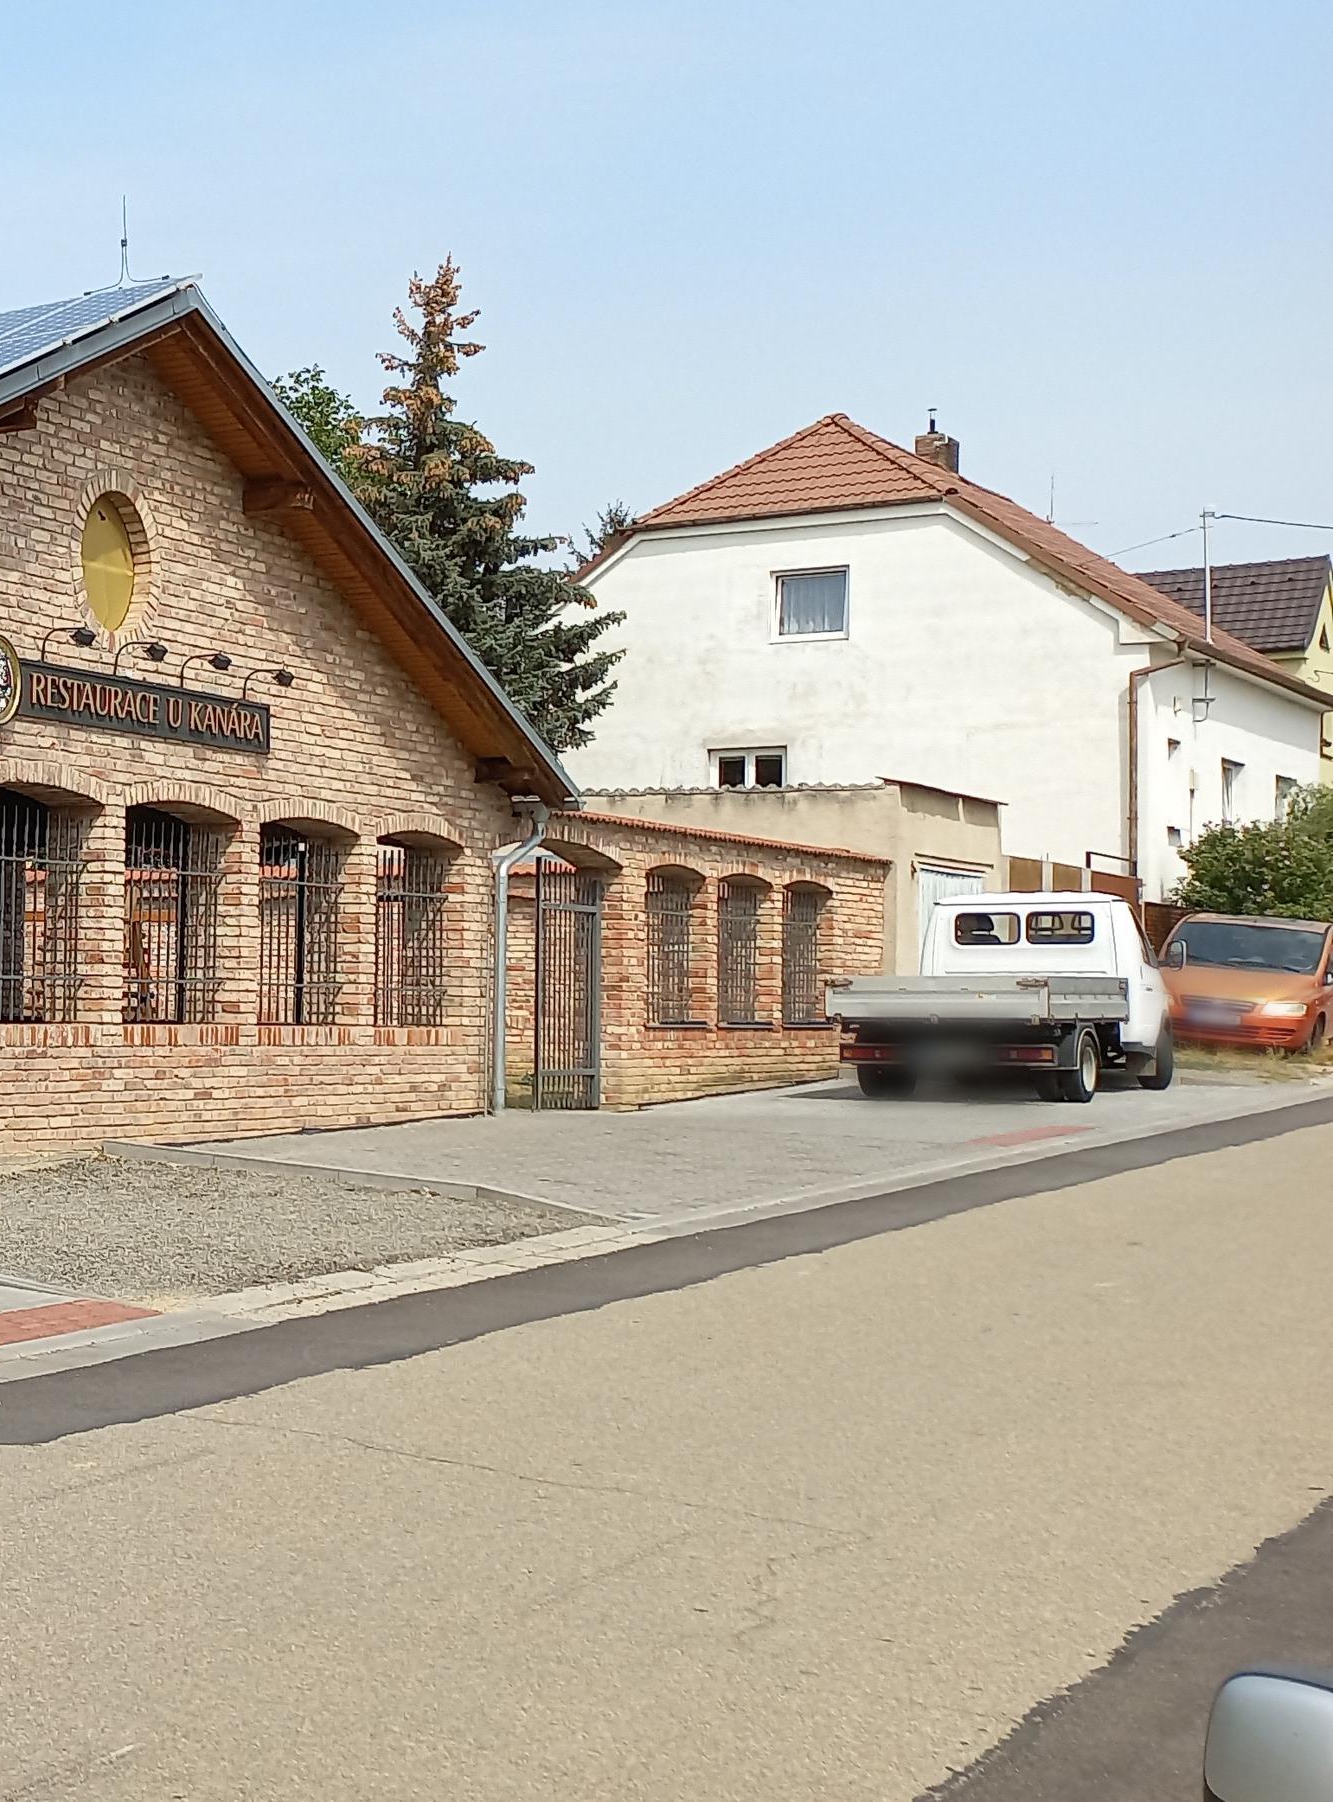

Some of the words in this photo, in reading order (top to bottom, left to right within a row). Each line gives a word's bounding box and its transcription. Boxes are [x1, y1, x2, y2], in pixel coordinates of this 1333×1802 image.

[29, 672, 160, 725] RESTAURACE
[167, 697, 183, 728] U
[189, 700, 264, 742] KANÁRA
